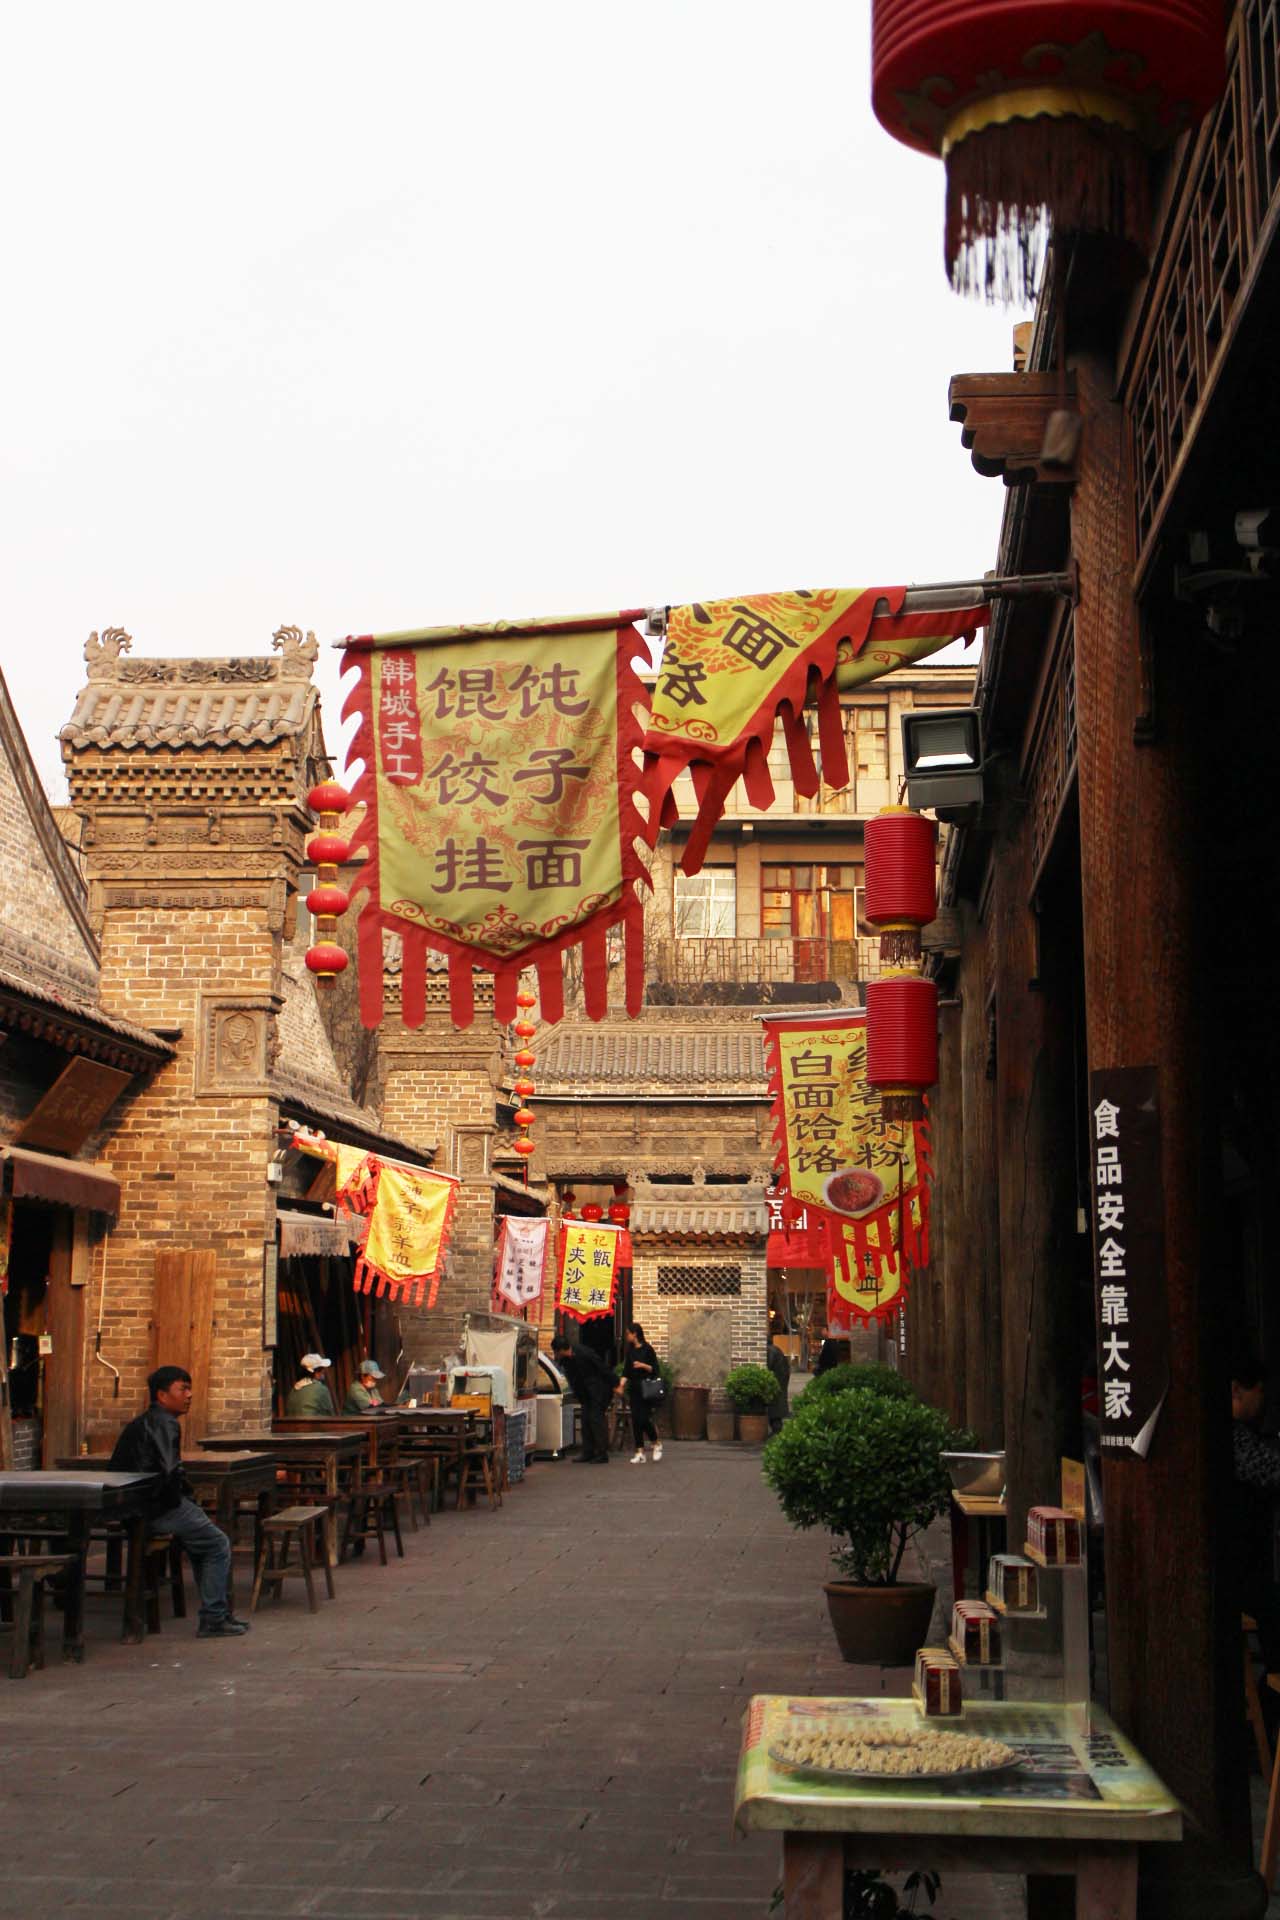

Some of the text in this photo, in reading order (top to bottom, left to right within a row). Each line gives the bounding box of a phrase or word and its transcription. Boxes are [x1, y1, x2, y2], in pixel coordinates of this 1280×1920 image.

[381, 657, 417, 780] 韩城手工
[427, 662, 590, 721] 馄饨
[428, 748, 591, 807] 饺子
[431, 837, 592, 896] 挂面
[787, 1050, 846, 1174] 白面饸饹
[563, 1246, 587, 1305] 夹沙糕
[588, 1248, 612, 1306] 甑糕
[1094, 1099, 1132, 1420] 食品安全靠大家
